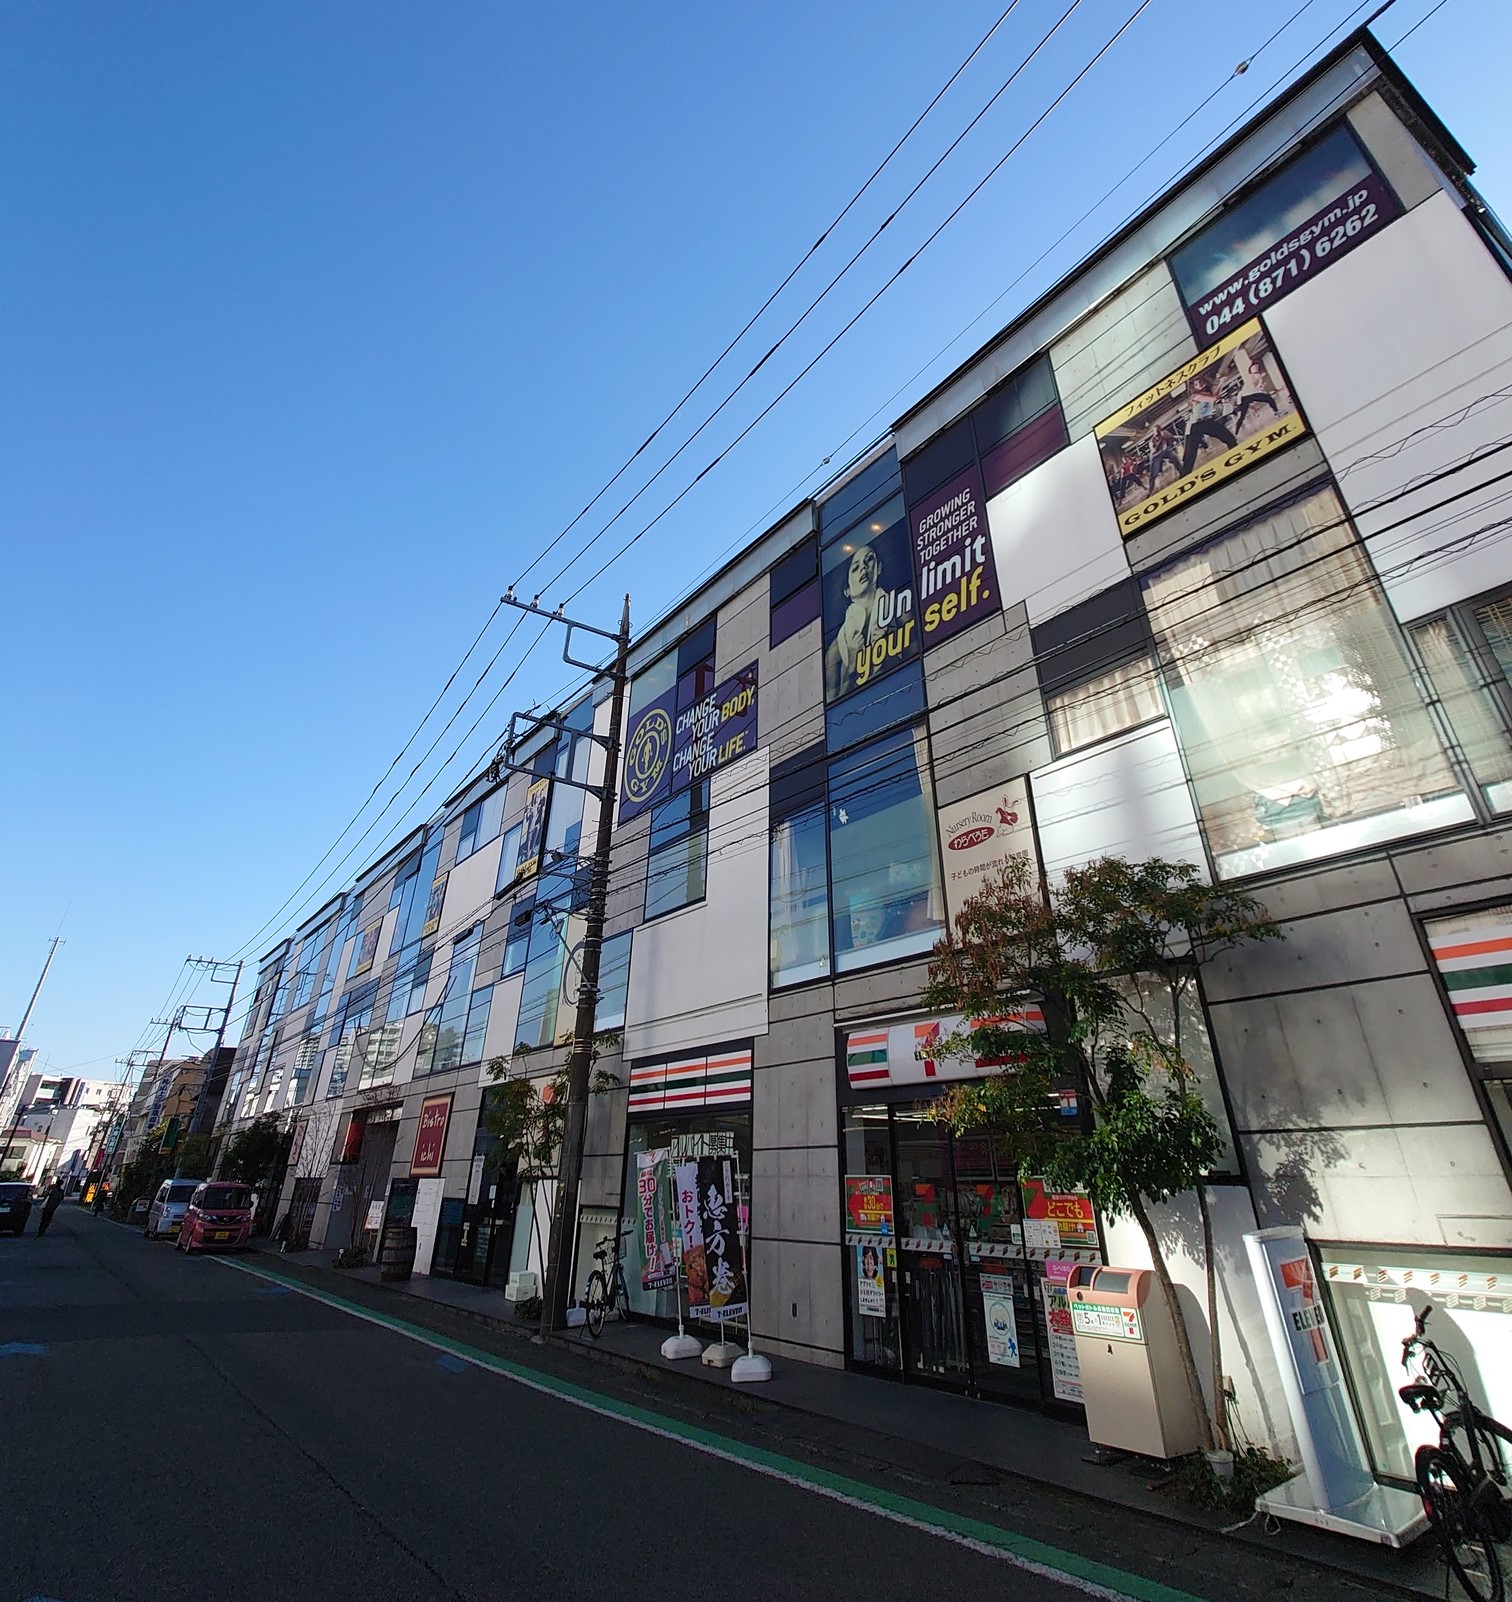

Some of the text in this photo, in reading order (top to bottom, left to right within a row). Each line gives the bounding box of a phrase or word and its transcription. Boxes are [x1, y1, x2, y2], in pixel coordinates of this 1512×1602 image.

[1198, 189, 1368, 316] www.goldsgym.jp
[1125, 345, 1222, 417] フィットネスクラブ
[1124, 424, 1292, 526] GOLD'S GYM
[917, 501, 976, 551] STRONGER
[919, 487, 971, 534] GROWING
[919, 515, 978, 564] TOGETHER
[877, 534, 986, 627] Un limit
[855, 565, 990, 686] your self.
[675, 692, 717, 735] CHANGE
[691, 684, 755, 741] YOUR BODY,
[629, 716, 668, 766] GOLD'S
[672, 731, 715, 772] CHANGE
[688, 747, 718, 781] YOUR
[945, 811, 993, 838] Nursery Room
[421, 1108, 445, 1129] Bistro
[1047, 1201, 1084, 1218] どこでも
[702, 1184, 735, 1295] 恵方巻
